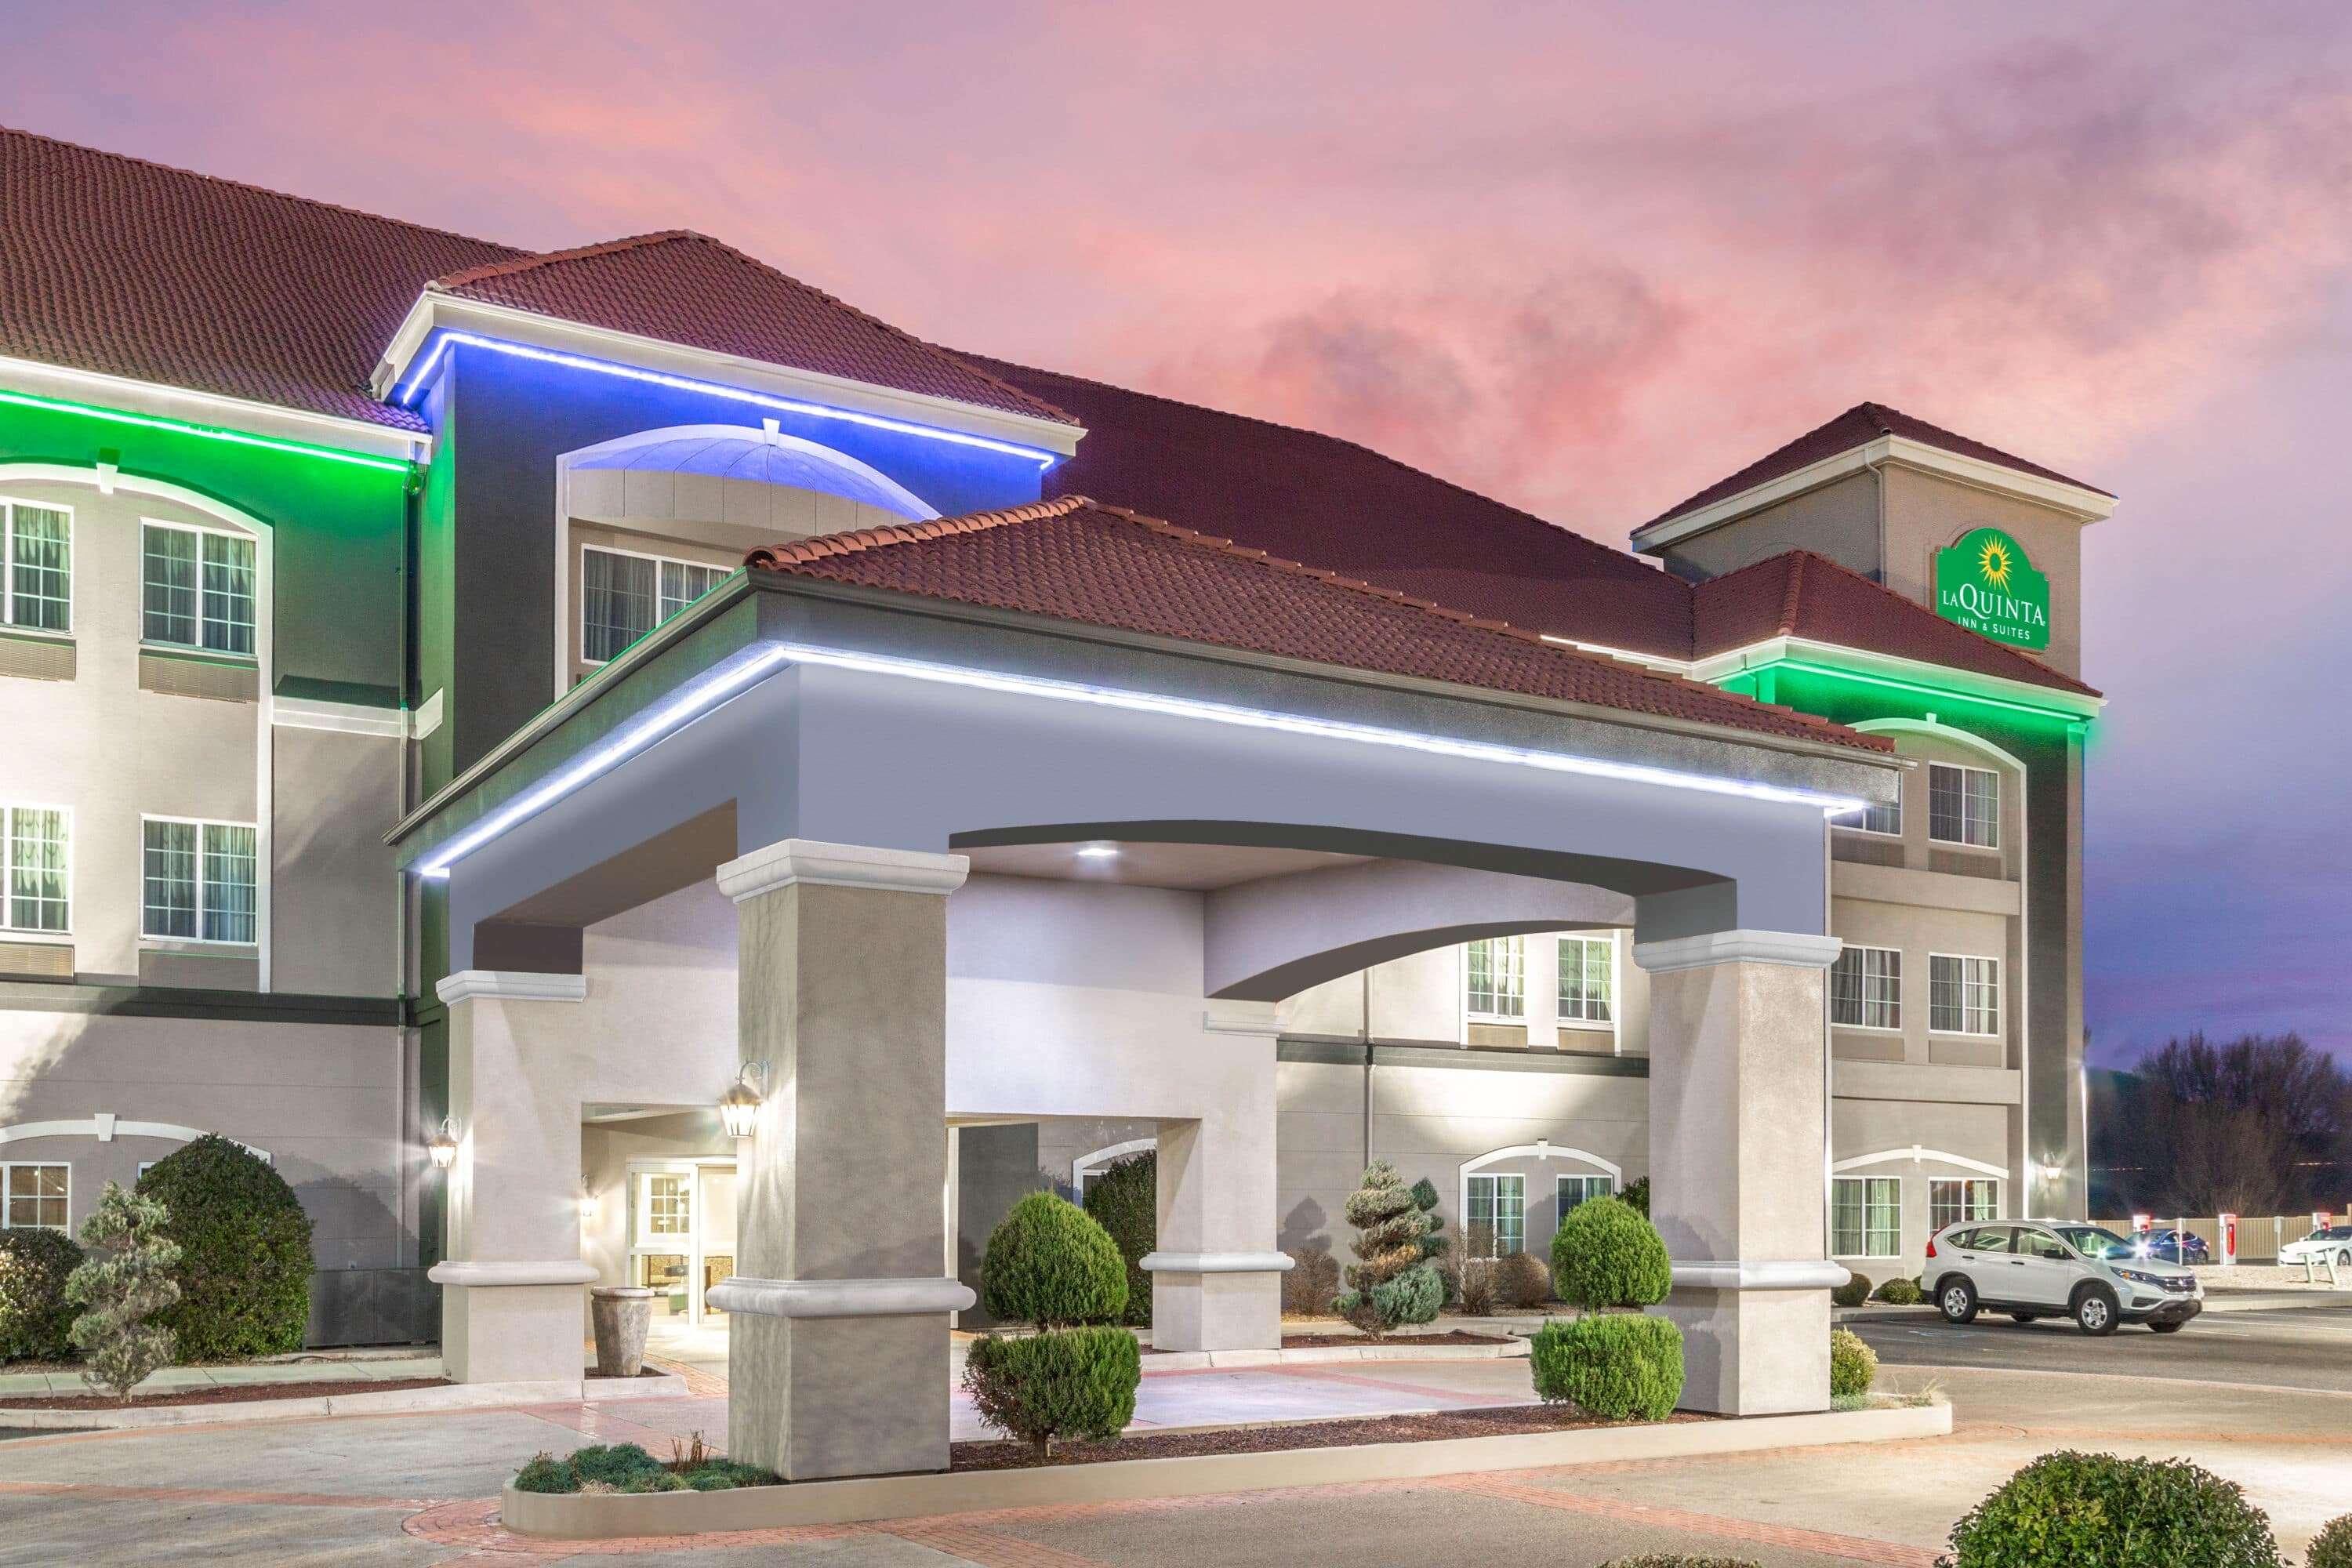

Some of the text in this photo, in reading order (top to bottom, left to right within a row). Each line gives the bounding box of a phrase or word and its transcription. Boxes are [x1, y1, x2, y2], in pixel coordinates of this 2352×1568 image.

[1943, 583, 2044, 626] LA QUINTA
[1958, 615, 2031, 640] INN & SUITES
